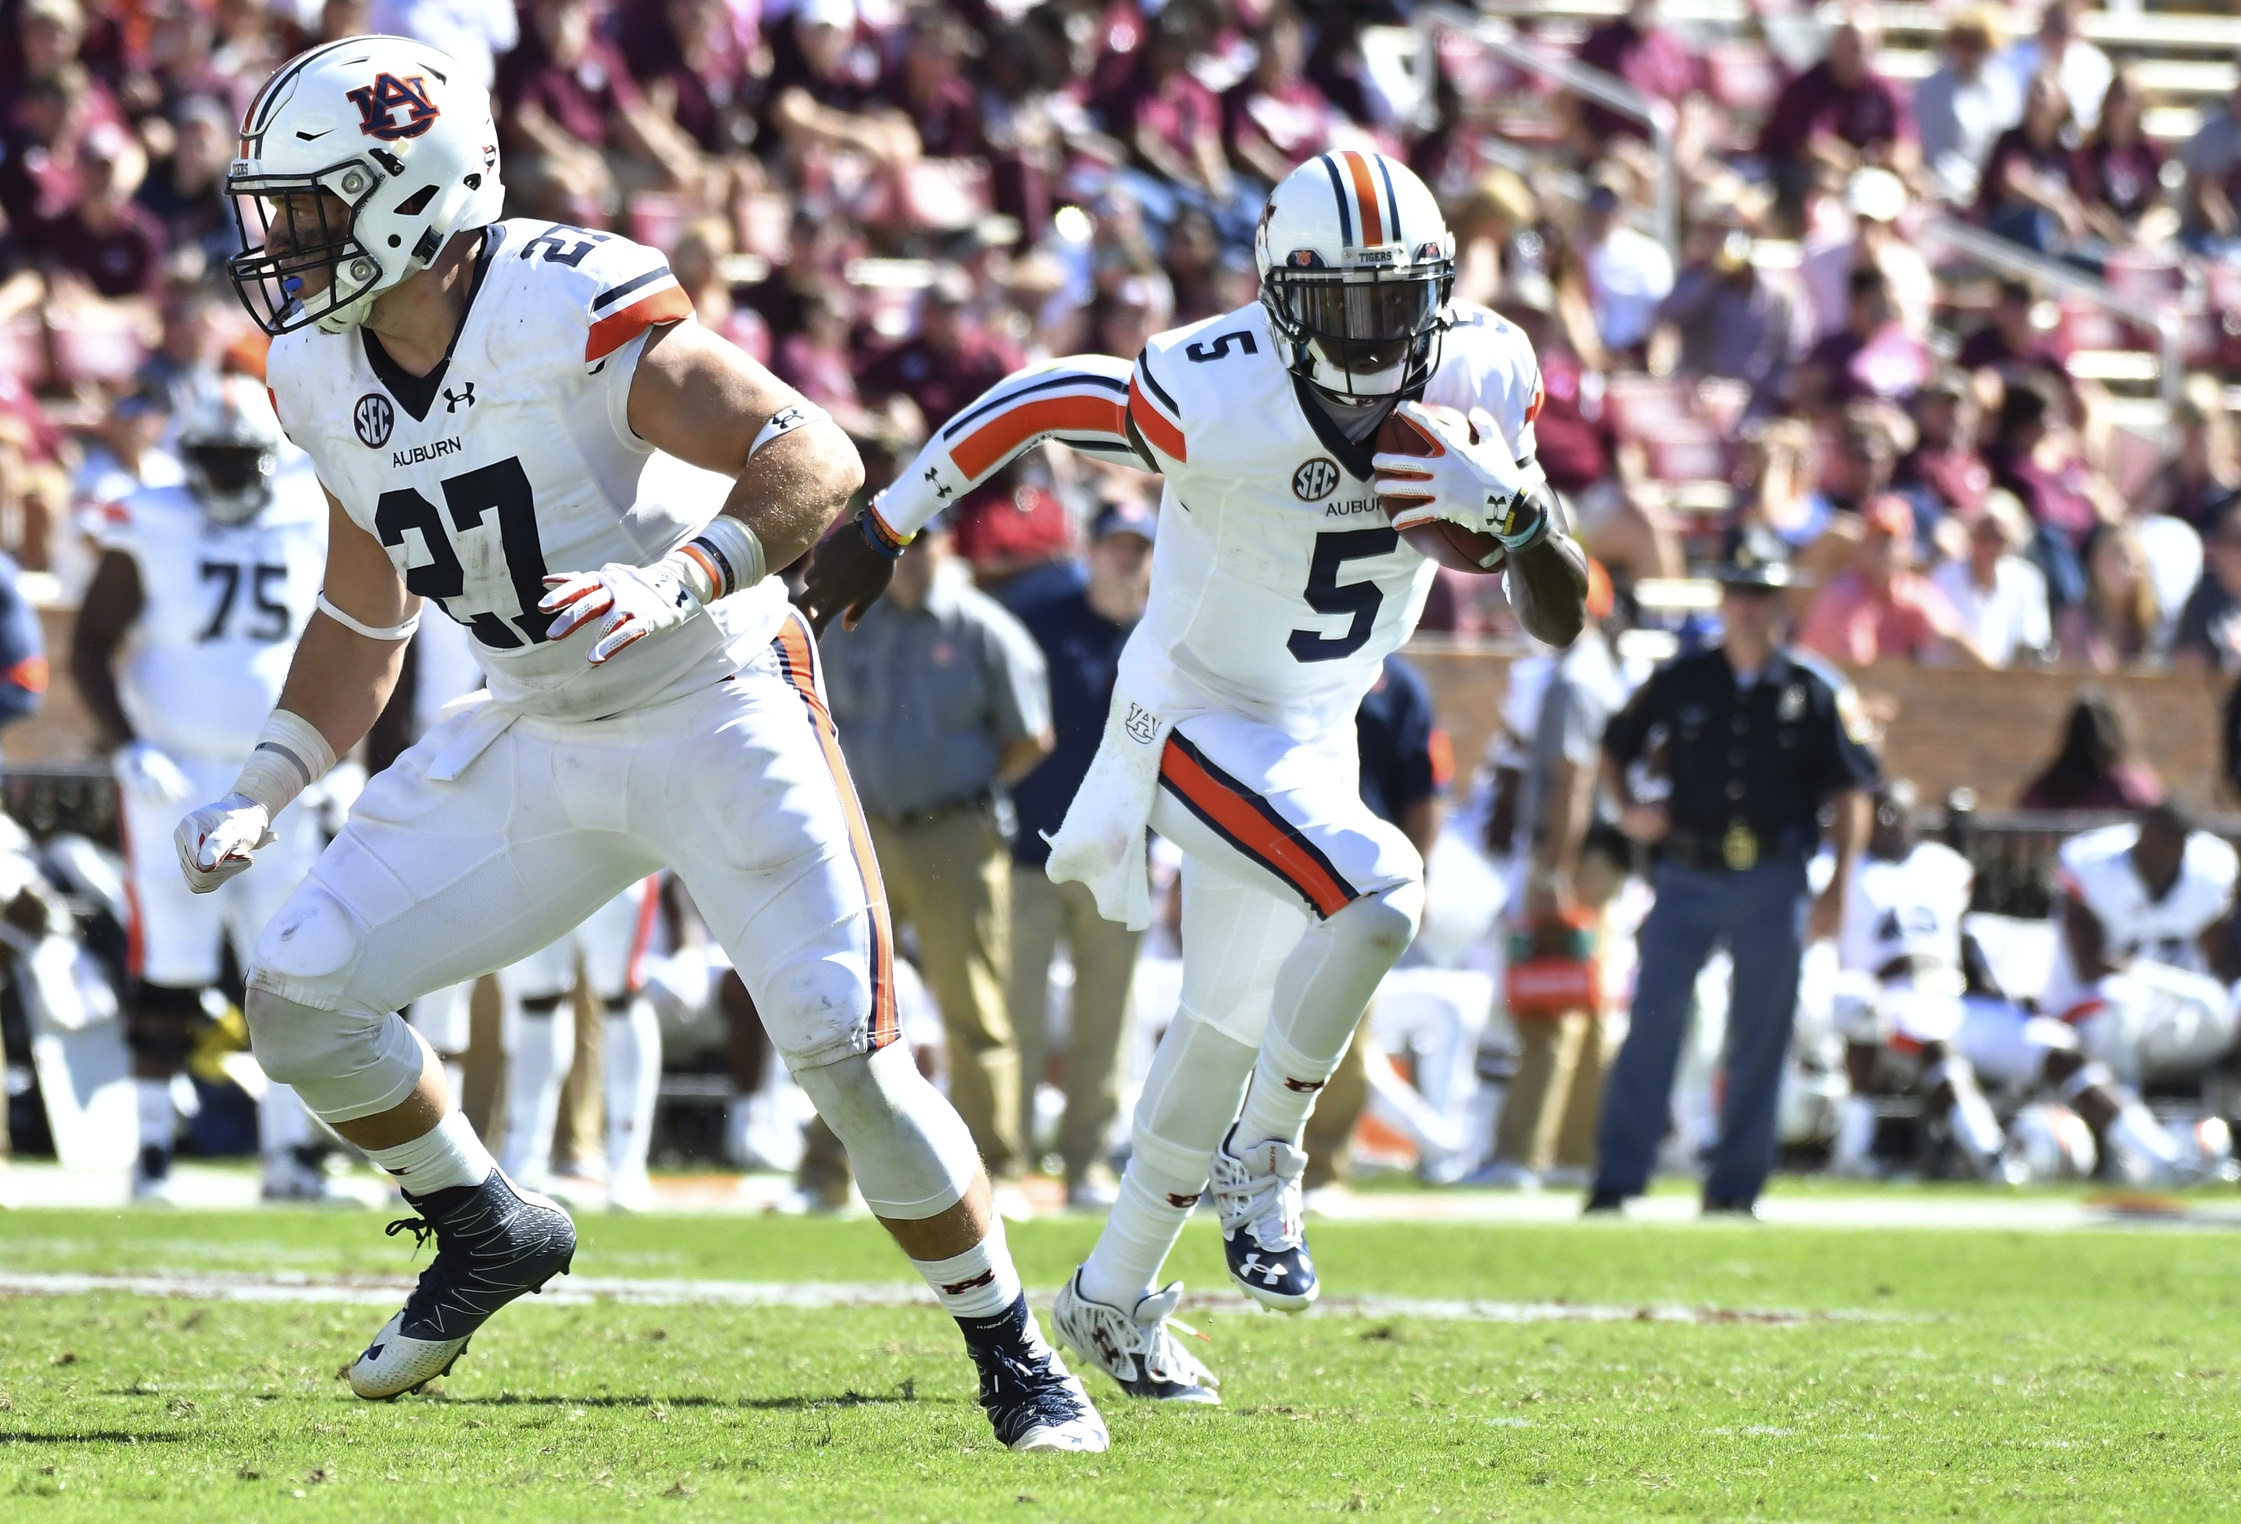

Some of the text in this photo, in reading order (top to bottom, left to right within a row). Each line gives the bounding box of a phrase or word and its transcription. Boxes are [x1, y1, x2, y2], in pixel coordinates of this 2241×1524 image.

[1358, 250, 1393, 264] TIGERS
[1184, 328, 1259, 364] 5
[355, 395, 393, 447] SEC
[392, 436, 462, 469] AUBURN
[1294, 459, 1339, 500] SEC
[374, 455, 560, 648] 27
[196, 561, 291, 643] 75
[1285, 525, 1400, 663] 5
